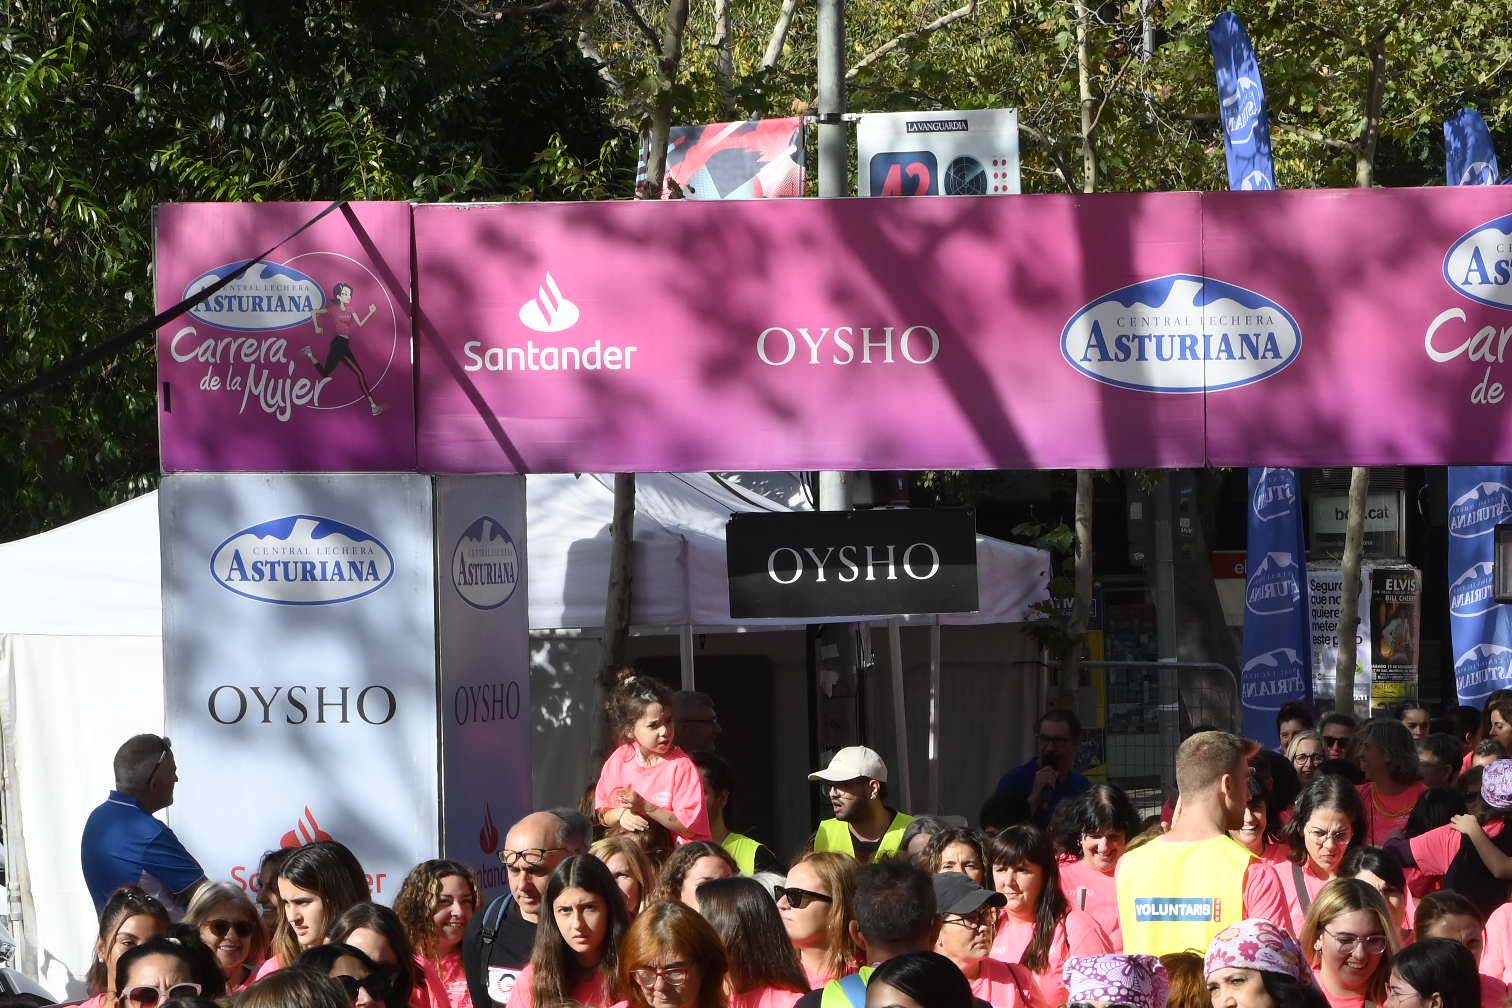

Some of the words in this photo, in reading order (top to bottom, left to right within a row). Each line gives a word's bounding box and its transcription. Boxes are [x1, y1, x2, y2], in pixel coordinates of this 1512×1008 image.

[1117, 315, 1191, 327] CENTRAL
[1201, 314, 1275, 327] LECHERA
[171, 326, 288, 364] Carrera
[463, 340, 637, 372] Santander
[756, 325, 940, 367] OYSHO
[1080, 323, 1283, 363] ASTURIANA
[200, 365, 221, 391] de
[226, 365, 242, 391] la
[239, 360, 333, 422] Mujer
[1470, 366, 1505, 404] de
[225, 549, 381, 582] ASTURIANA
[253, 546, 311, 555] CENTRAL
[316, 546, 375, 555] LECHERA
[767, 543, 940, 585] OYSHO
[457, 558, 516, 587] ASTURIANA
[1385, 578, 1416, 591] ELVIS
[1311, 607, 1345, 620] quiere
[208, 685, 397, 725] OYSHO
[454, 680, 521, 726] OYSHO
[1136, 903, 1211, 916] VOLUNTARIS
